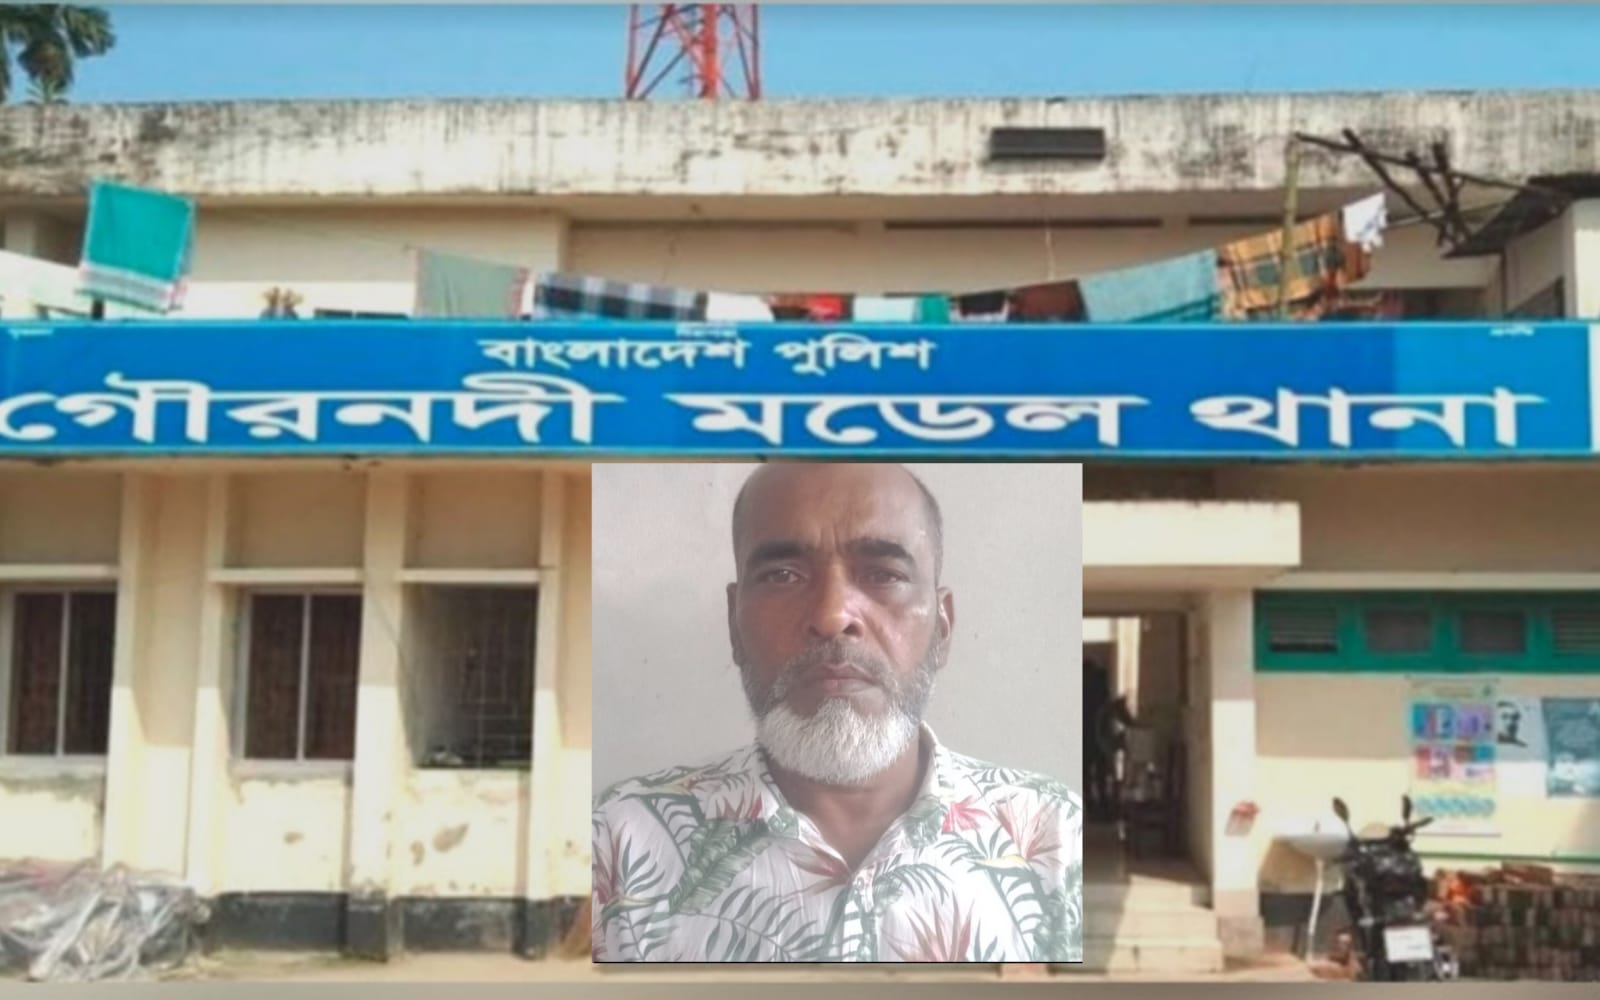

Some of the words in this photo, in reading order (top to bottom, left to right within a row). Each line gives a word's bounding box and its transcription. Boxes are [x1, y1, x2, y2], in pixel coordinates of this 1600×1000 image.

[479, 338, 751, 370] বাংলাদেশ
[774, 332, 936, 376] পুলিশ
[0, 372, 627, 443] গৌরনদী
[663, 394, 1151, 447] মডেল
[1189, 386, 1547, 448] থানা
